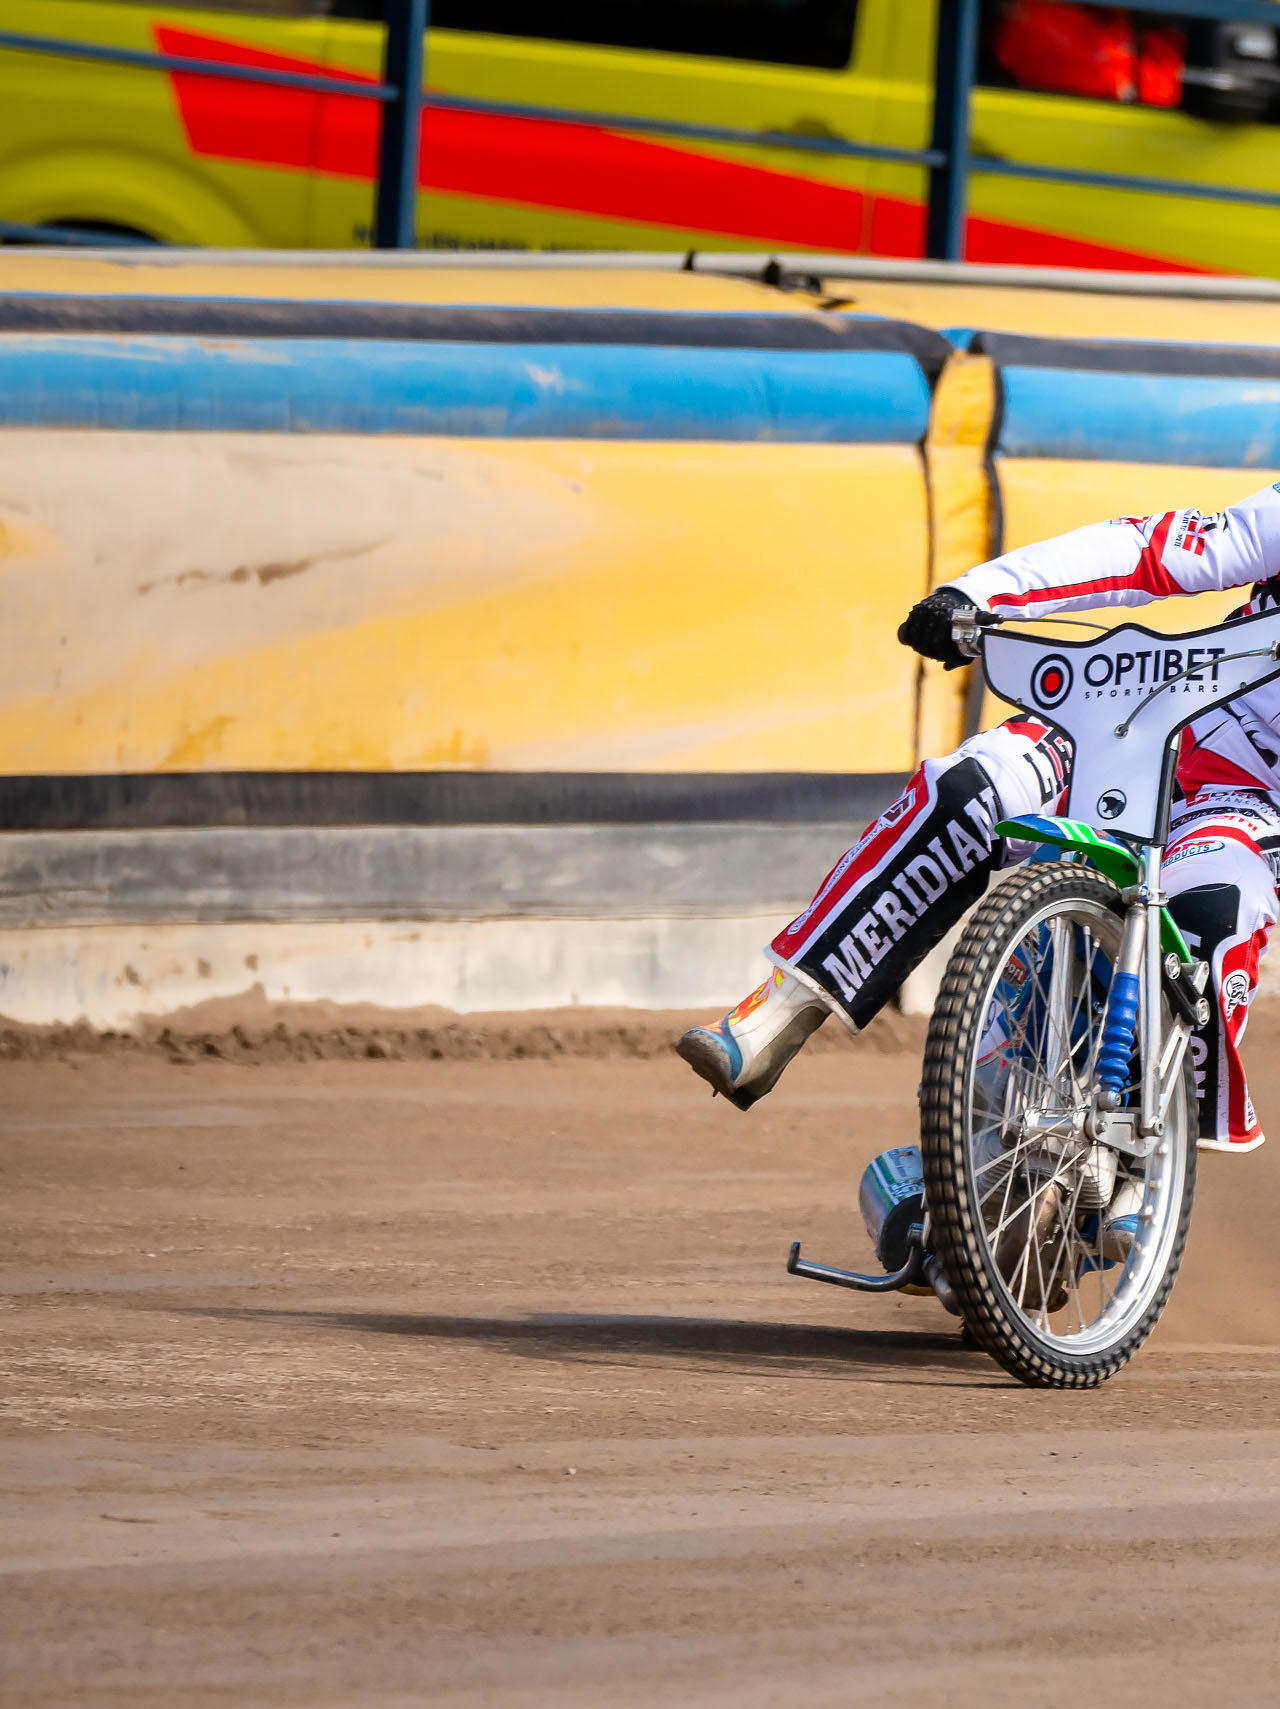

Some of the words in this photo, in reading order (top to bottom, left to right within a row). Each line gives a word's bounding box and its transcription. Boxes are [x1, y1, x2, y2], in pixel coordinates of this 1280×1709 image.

[1083, 647, 1226, 688] OPTIBET
[1084, 685, 1154, 700] SPORTA
[1161, 844, 1211, 869] RODUCTS
[821, 785, 1001, 1003] MERIDIAN
